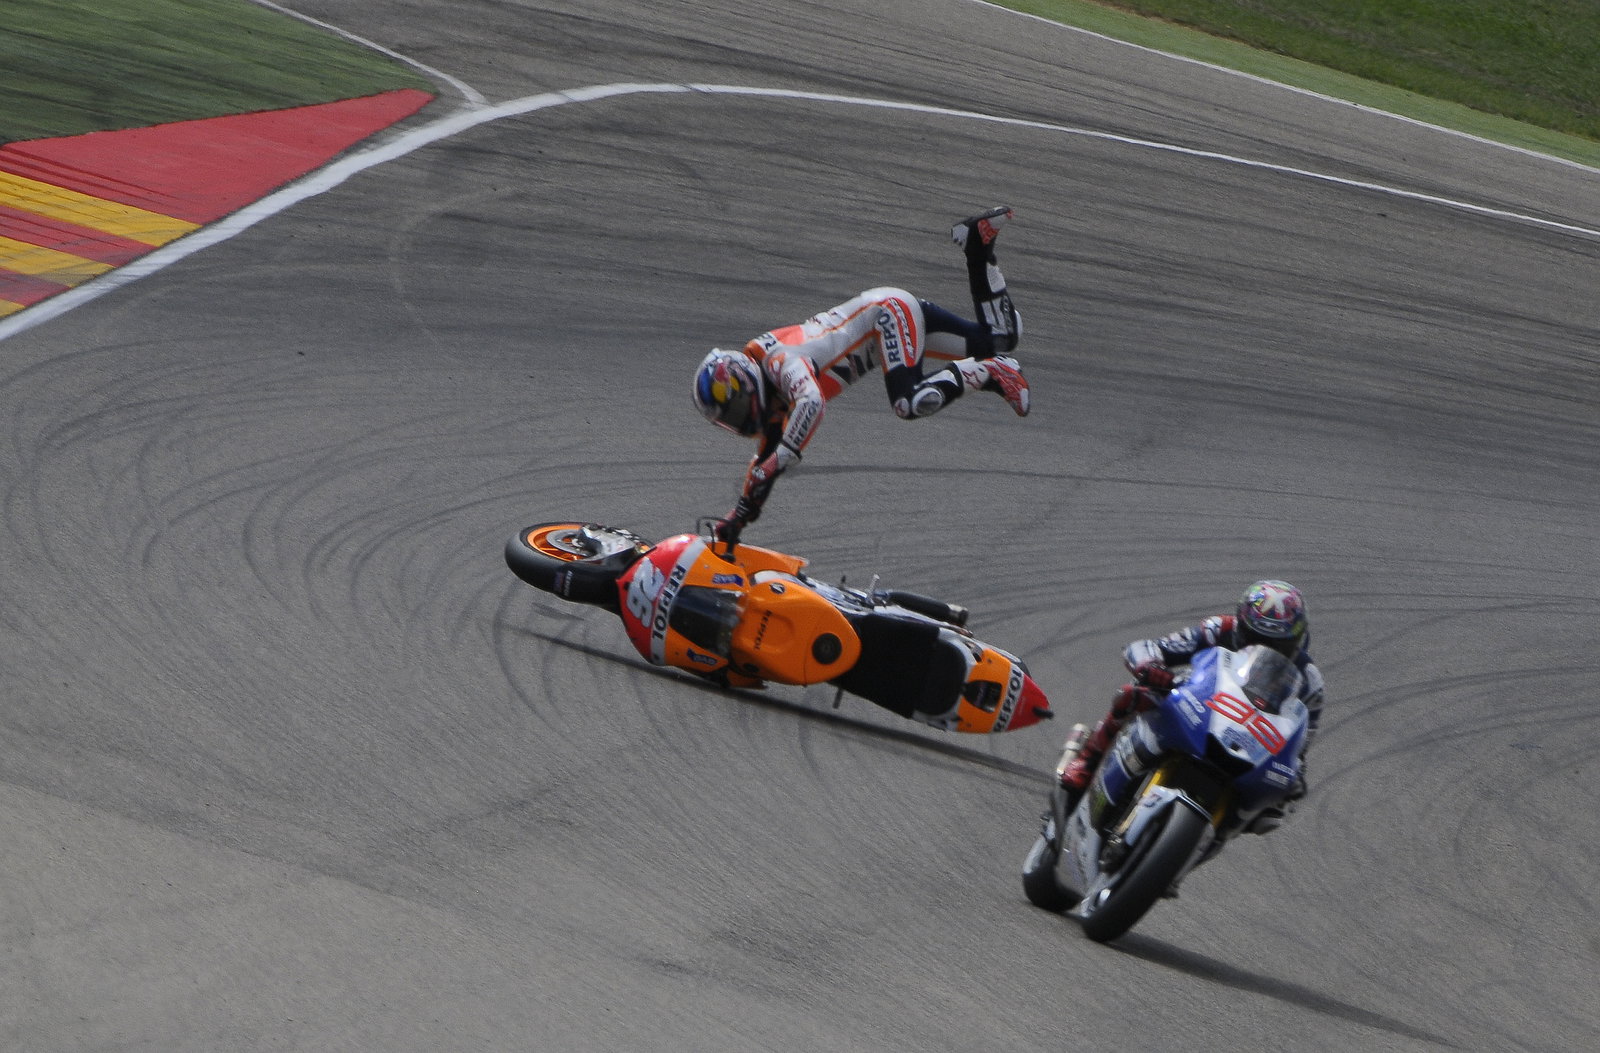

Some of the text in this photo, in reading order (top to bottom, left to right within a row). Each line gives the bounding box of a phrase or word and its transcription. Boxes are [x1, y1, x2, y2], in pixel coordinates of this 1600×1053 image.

[626, 556, 665, 628] 26
[652, 565, 686, 639] REPSOL
[1205, 691, 1288, 756] 99
